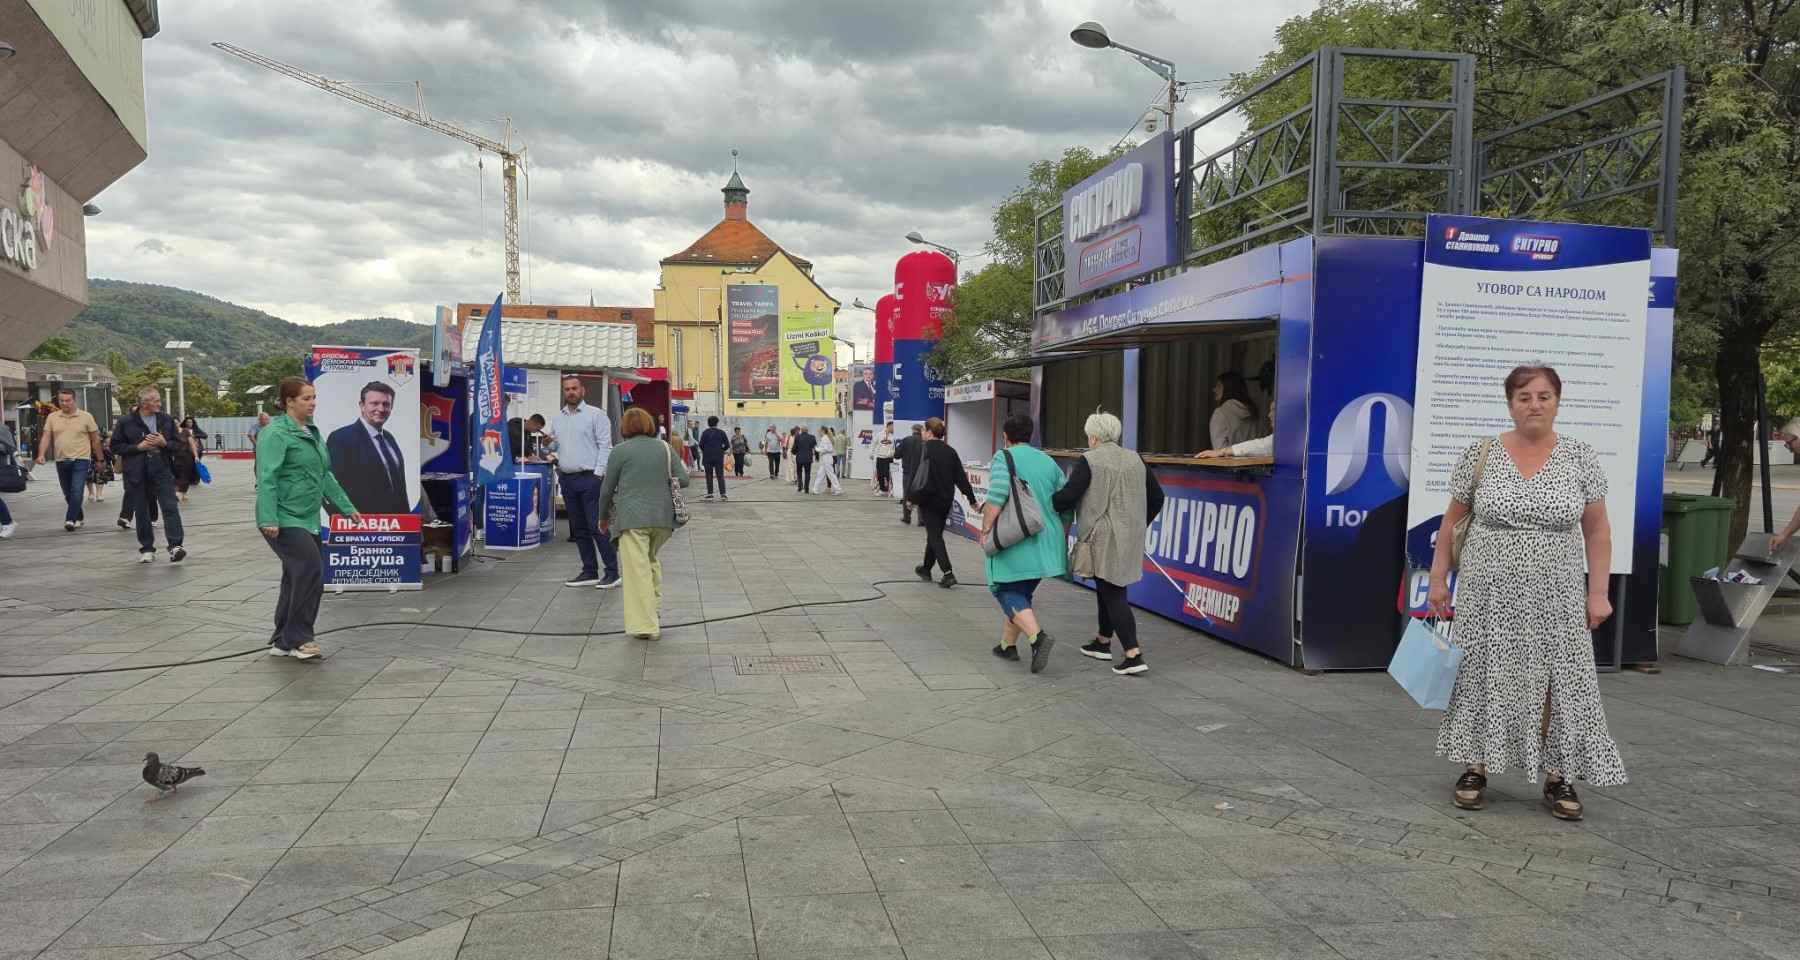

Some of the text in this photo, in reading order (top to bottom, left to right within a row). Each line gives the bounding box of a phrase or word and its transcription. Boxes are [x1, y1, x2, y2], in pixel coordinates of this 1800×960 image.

[1513, 237, 1558, 253] СИГУРНО
[1476, 282, 1606, 300] УГОВОР СА НАРОДОМ
[786, 331, 804, 341] Uzmi
[350, 545, 393, 556] Бранко
[329, 553, 404, 568] Блануша
[334, 569, 399, 578] ПРЕДСЈЕДНИК
[1187, 583, 1240, 623] ПРЕМИЈЕР
